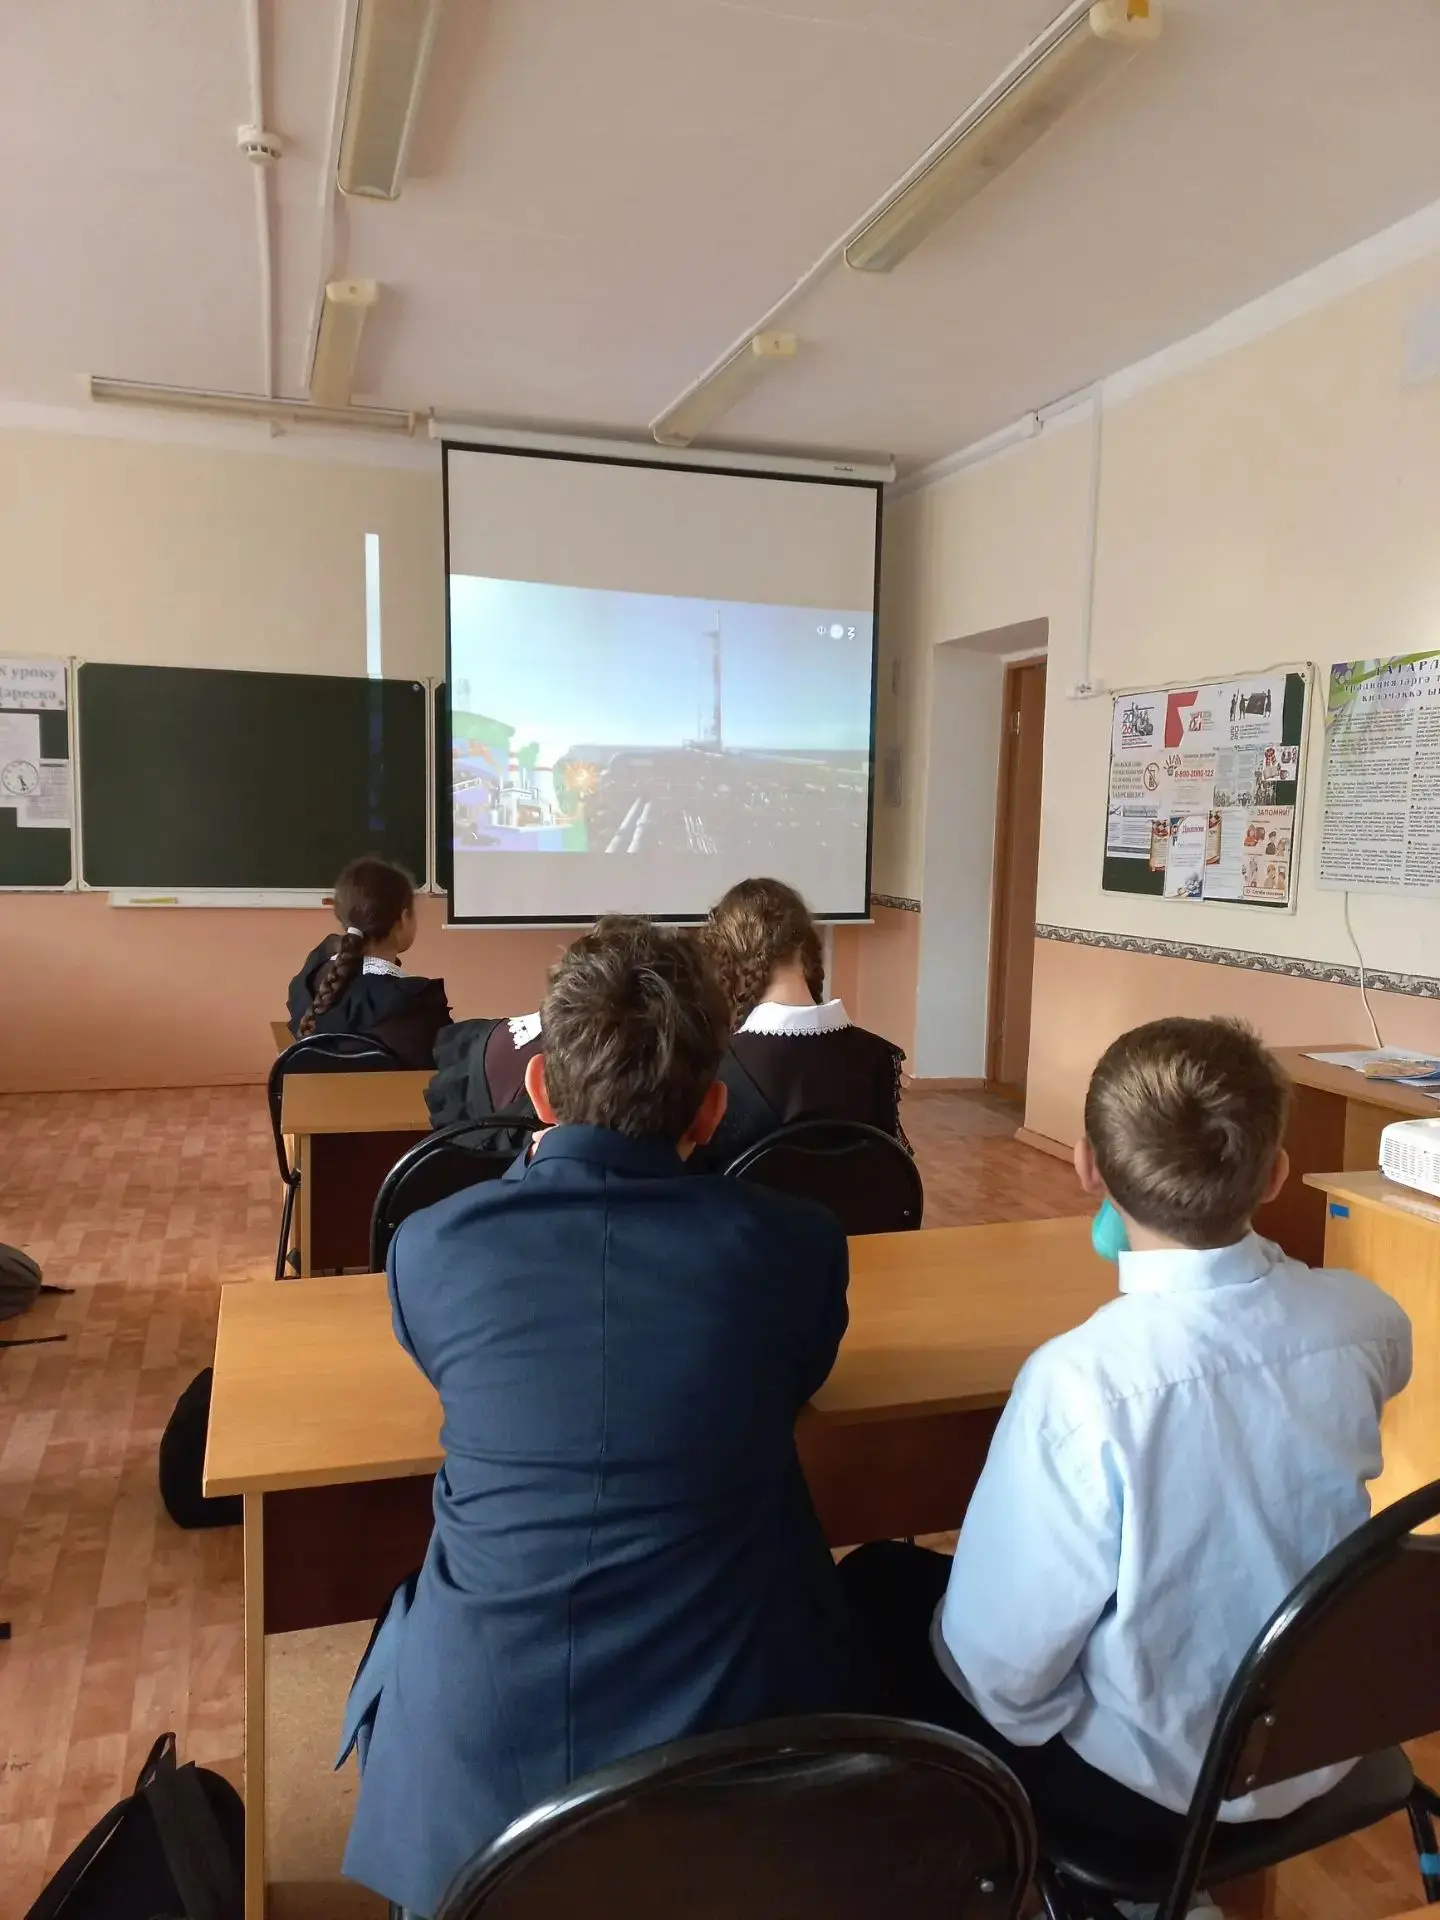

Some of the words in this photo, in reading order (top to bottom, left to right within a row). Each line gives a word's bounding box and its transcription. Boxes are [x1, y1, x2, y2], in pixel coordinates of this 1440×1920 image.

[10, 667, 58, 681] уроку
[0, 687, 56, 701] әрескә
[1123, 712, 1134, 724] 20
[1256, 808, 1290, 817] ЗАПОМНИ!
